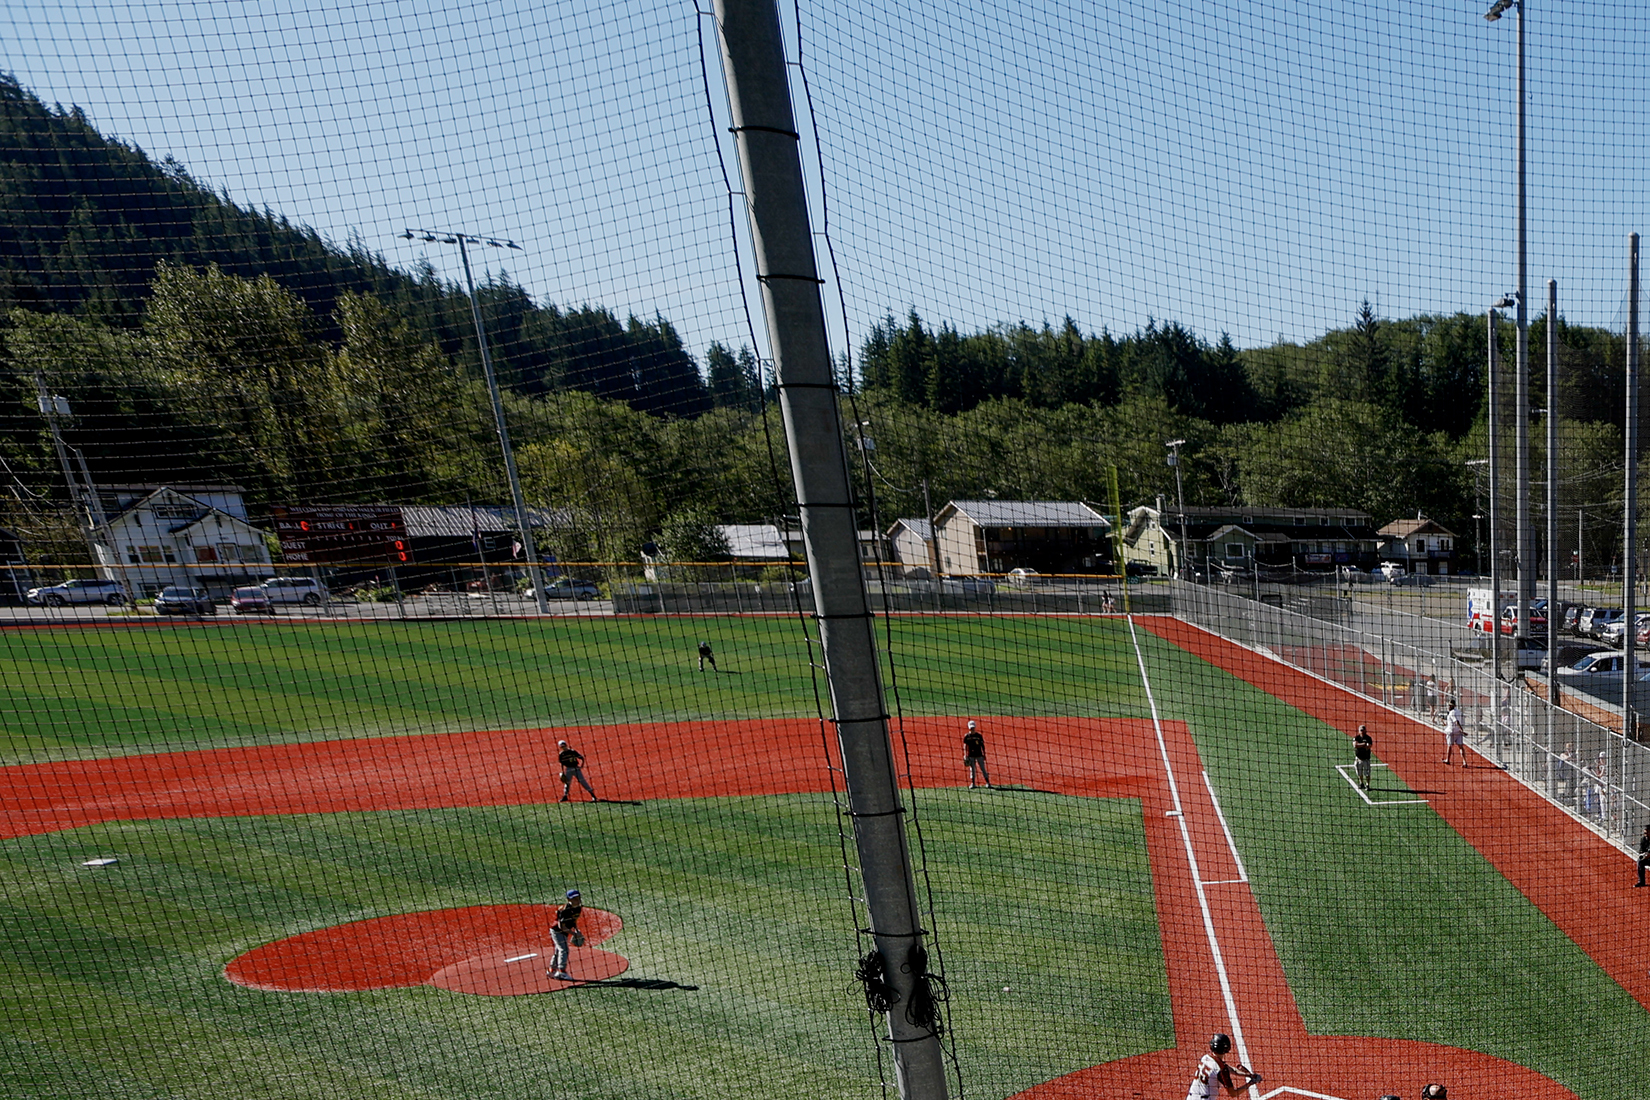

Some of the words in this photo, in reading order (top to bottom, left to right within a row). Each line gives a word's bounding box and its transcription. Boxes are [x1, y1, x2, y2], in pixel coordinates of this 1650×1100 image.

[279, 522, 301, 530] BALL
[316, 522, 347, 530] STRIKE
[369, 522, 388, 530] OUT
[281, 541, 306, 550] GUEST
[394, 540, 404, 550] 0
[285, 553, 310, 561] HOME
[398, 551, 407, 562] 0
